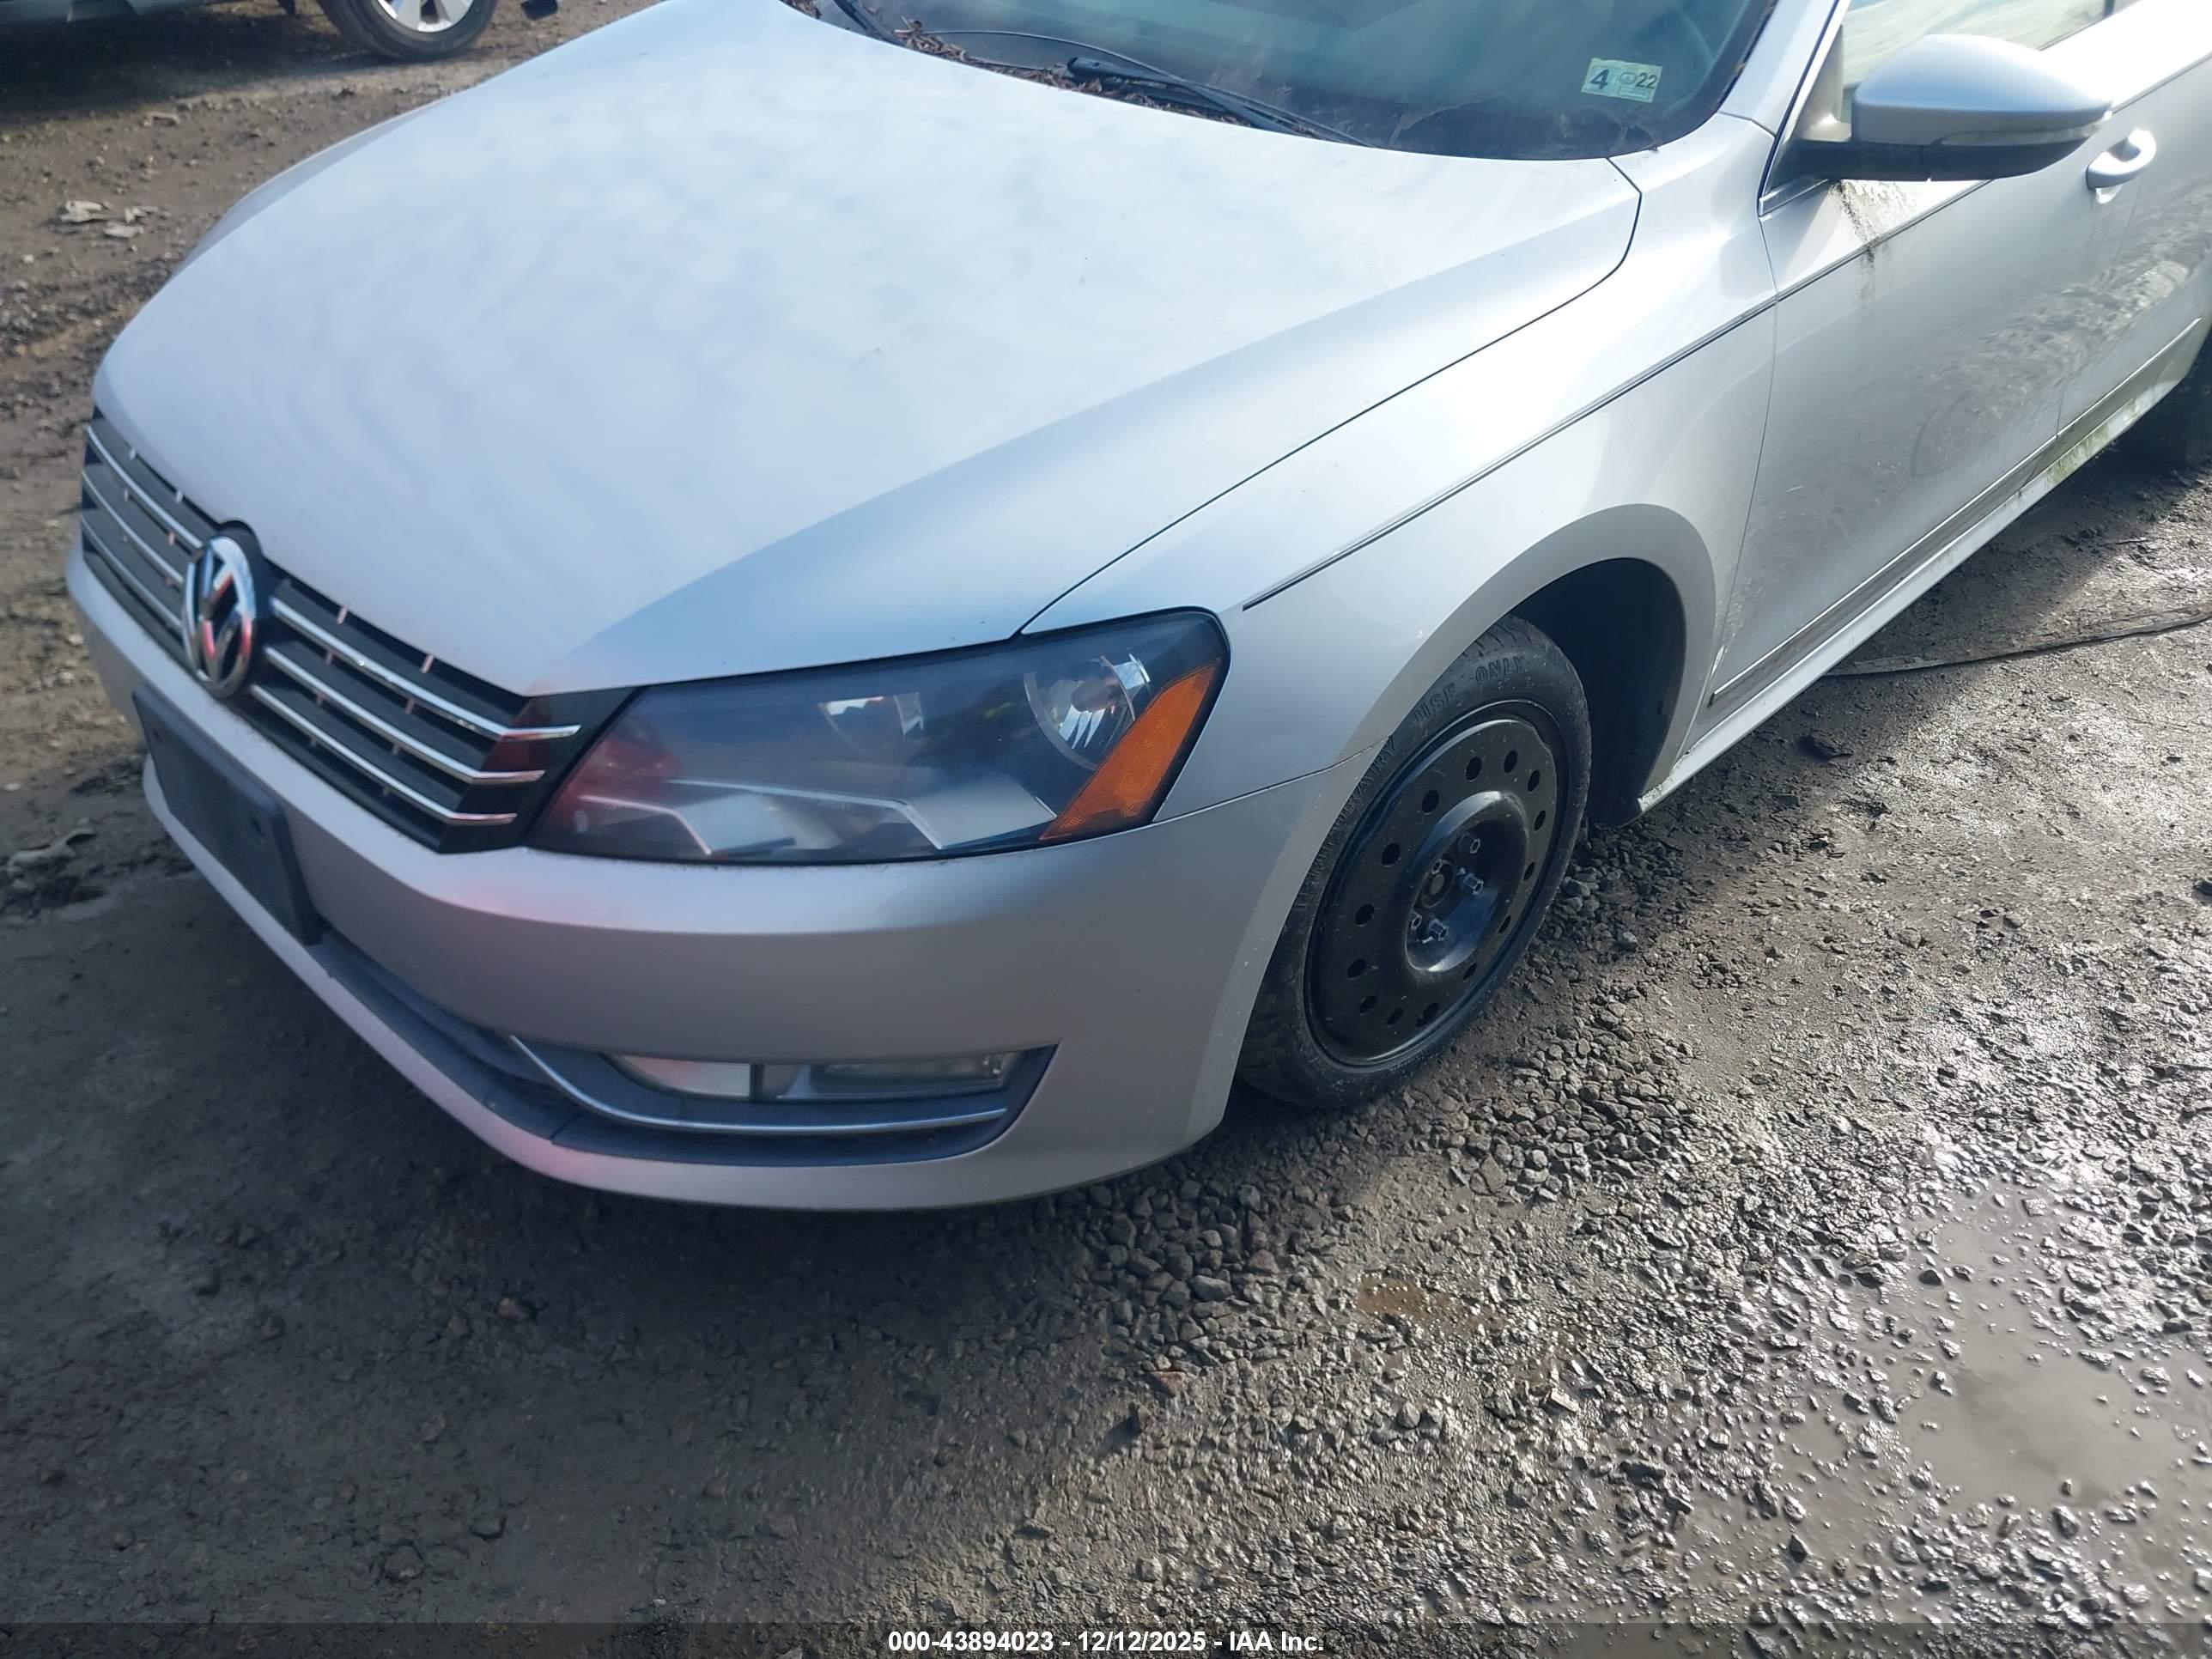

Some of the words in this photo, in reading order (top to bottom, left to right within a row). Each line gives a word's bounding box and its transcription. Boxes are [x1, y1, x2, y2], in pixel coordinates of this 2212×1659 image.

[1590, 69, 1610, 89] 4
[1635, 72, 1657, 89] 22
[1474, 655, 1526, 683] ONLY
